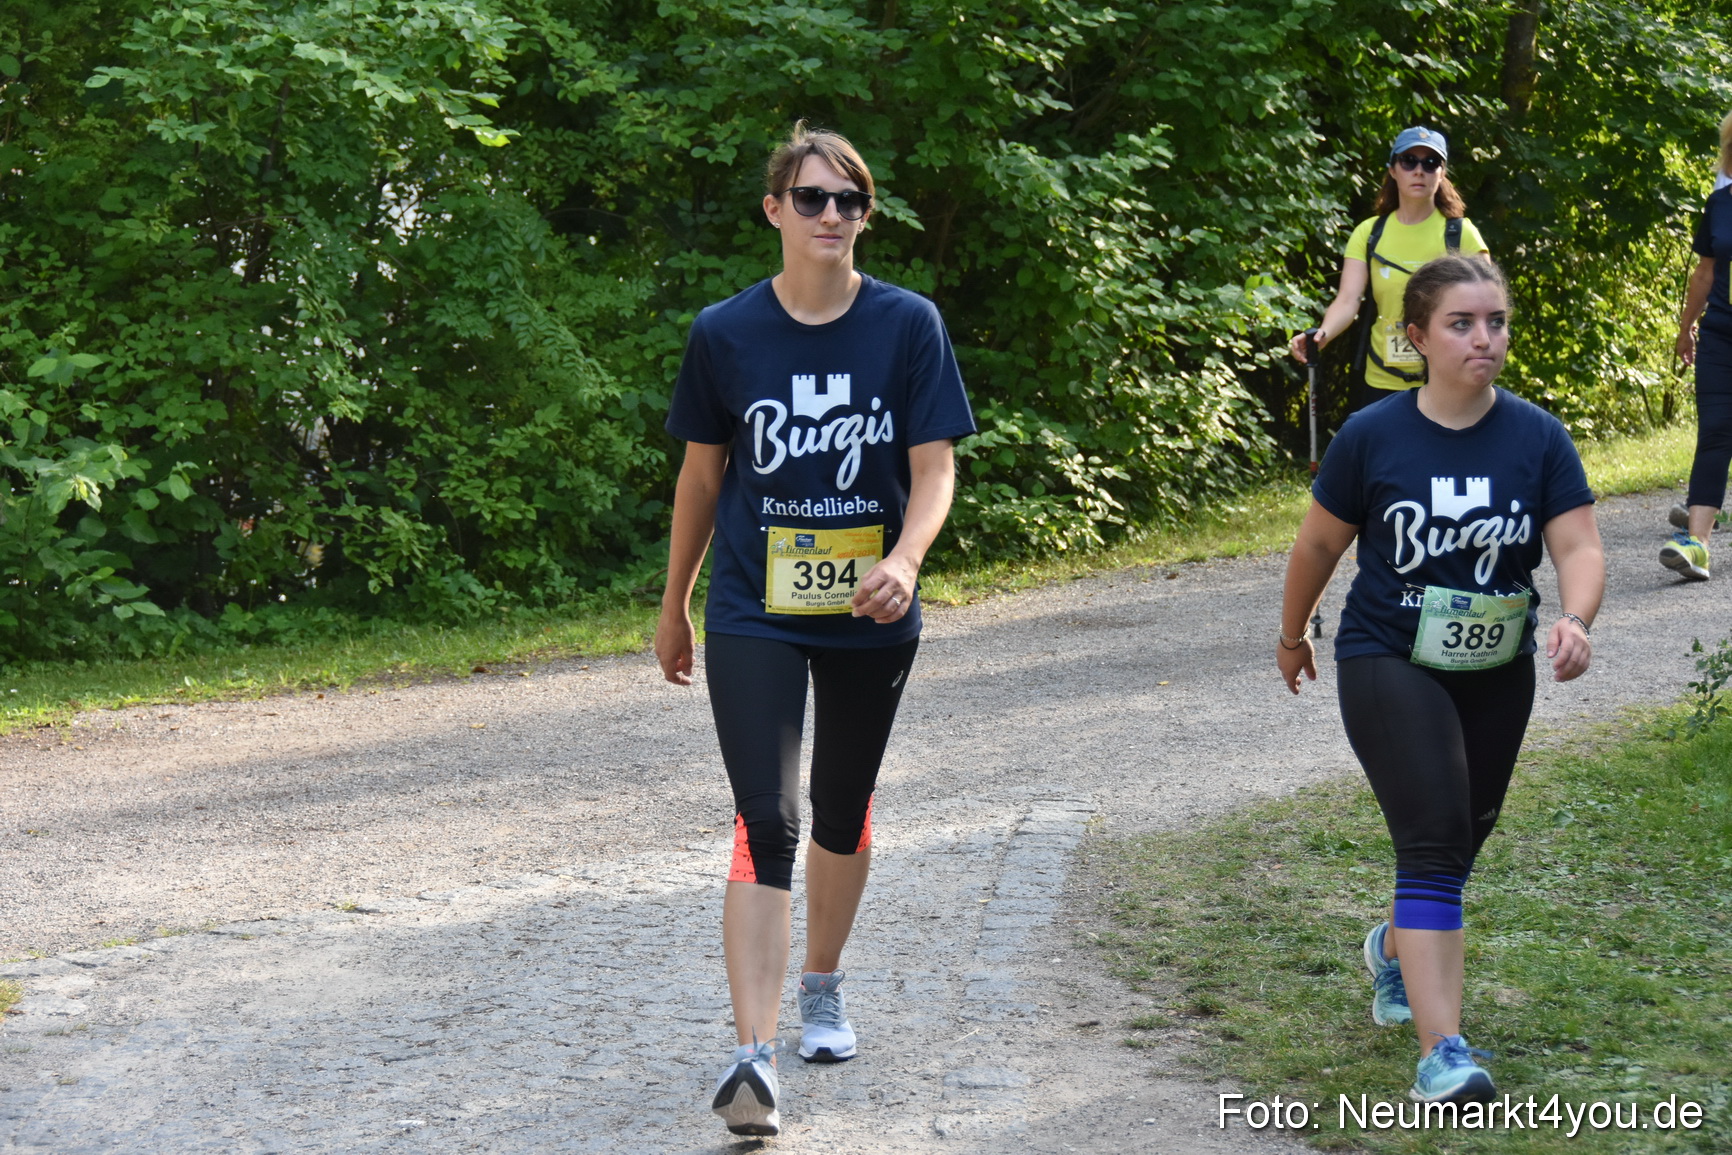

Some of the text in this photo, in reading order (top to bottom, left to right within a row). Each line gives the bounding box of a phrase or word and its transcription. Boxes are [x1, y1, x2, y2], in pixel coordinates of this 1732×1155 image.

[744, 397, 894, 491] Burgis
[762, 496, 884, 518] Knödelliebe.
[786, 545, 833, 555] firmenlauf
[1383, 500, 1530, 586] Burgis
[793, 559, 858, 591] 394
[791, 592, 822, 600] Paulus
[1440, 605, 1487, 618] firmenlauf
[1442, 621, 1505, 650] 389
[1441, 650, 1498, 658] Harrer Kathrin
